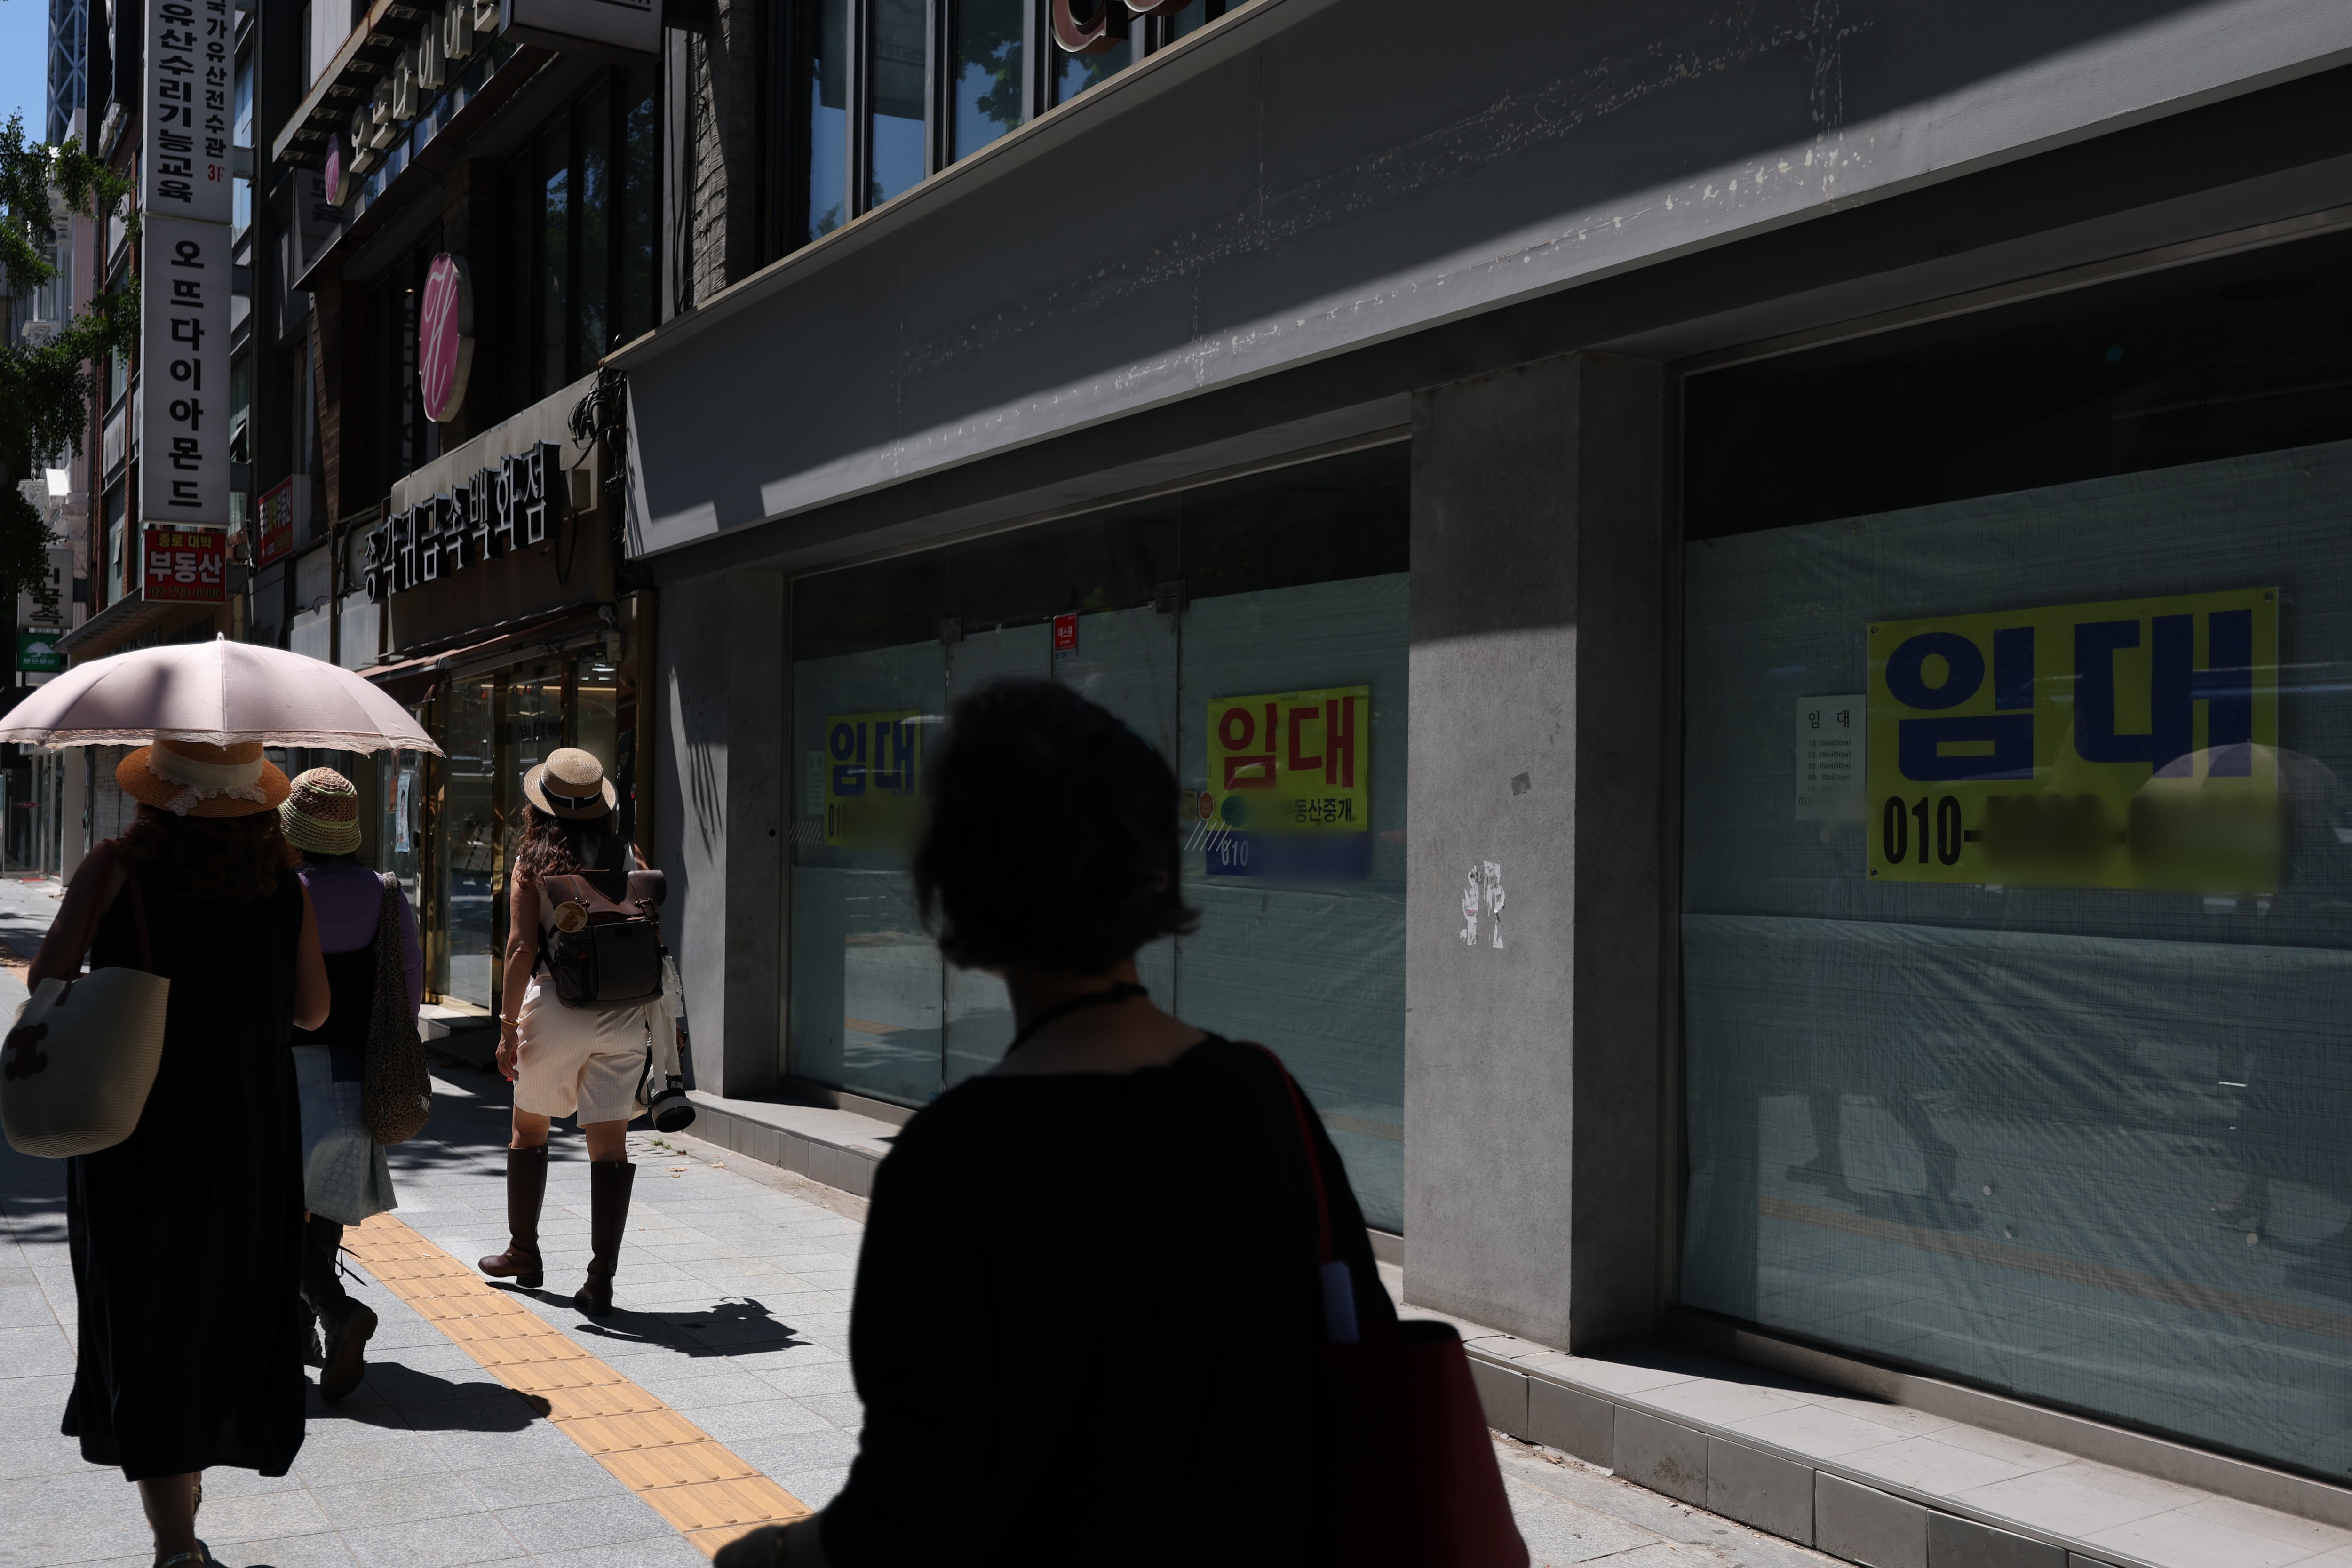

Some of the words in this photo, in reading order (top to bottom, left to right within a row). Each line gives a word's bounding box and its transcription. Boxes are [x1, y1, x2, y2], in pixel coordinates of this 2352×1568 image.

[159, 0, 196, 202] 유산수리기능교육
[207, 164, 225, 182] 3F
[168, 240, 205, 508] 오뜨다이아몬드
[158, 533, 183, 548] 종로
[187, 534, 213, 550] 대박
[363, 439, 551, 604] 종각귀금속백화점
[149, 550, 222, 584] 부동산
[150, 586, 221, 600] 02-723-0780
[1057, 625, 1073, 638] 에스원
[1885, 608, 2252, 781] 임대
[830, 720, 915, 796] 임대
[1218, 696, 1355, 790] 임대
[1288, 797, 1353, 823] 동산중개
